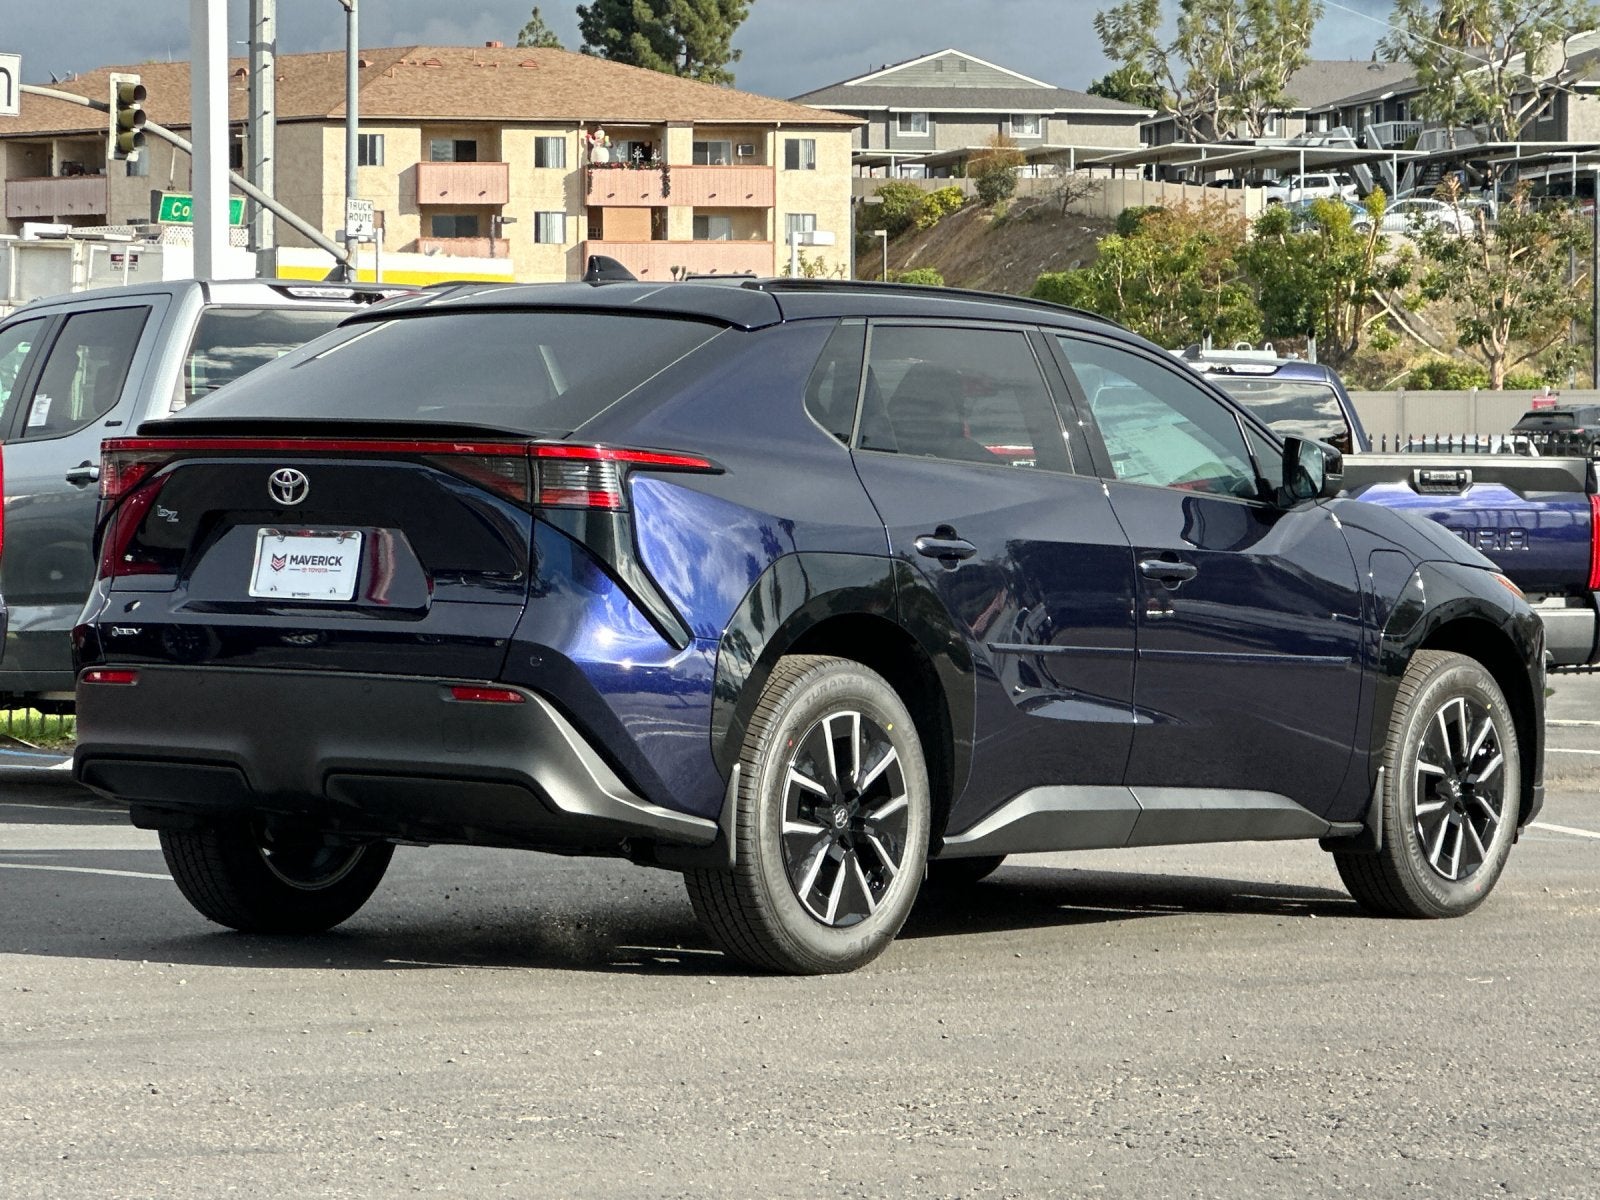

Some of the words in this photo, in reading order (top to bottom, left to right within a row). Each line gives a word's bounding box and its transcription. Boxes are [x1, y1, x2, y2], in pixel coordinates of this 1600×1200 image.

[171, 201, 190, 217] Co
[348, 201, 373, 212] TRUCK
[348, 212, 372, 222] ROUTE
[289, 554, 343, 567] MAVERICK
[802, 676, 864, 706] TURANZA
